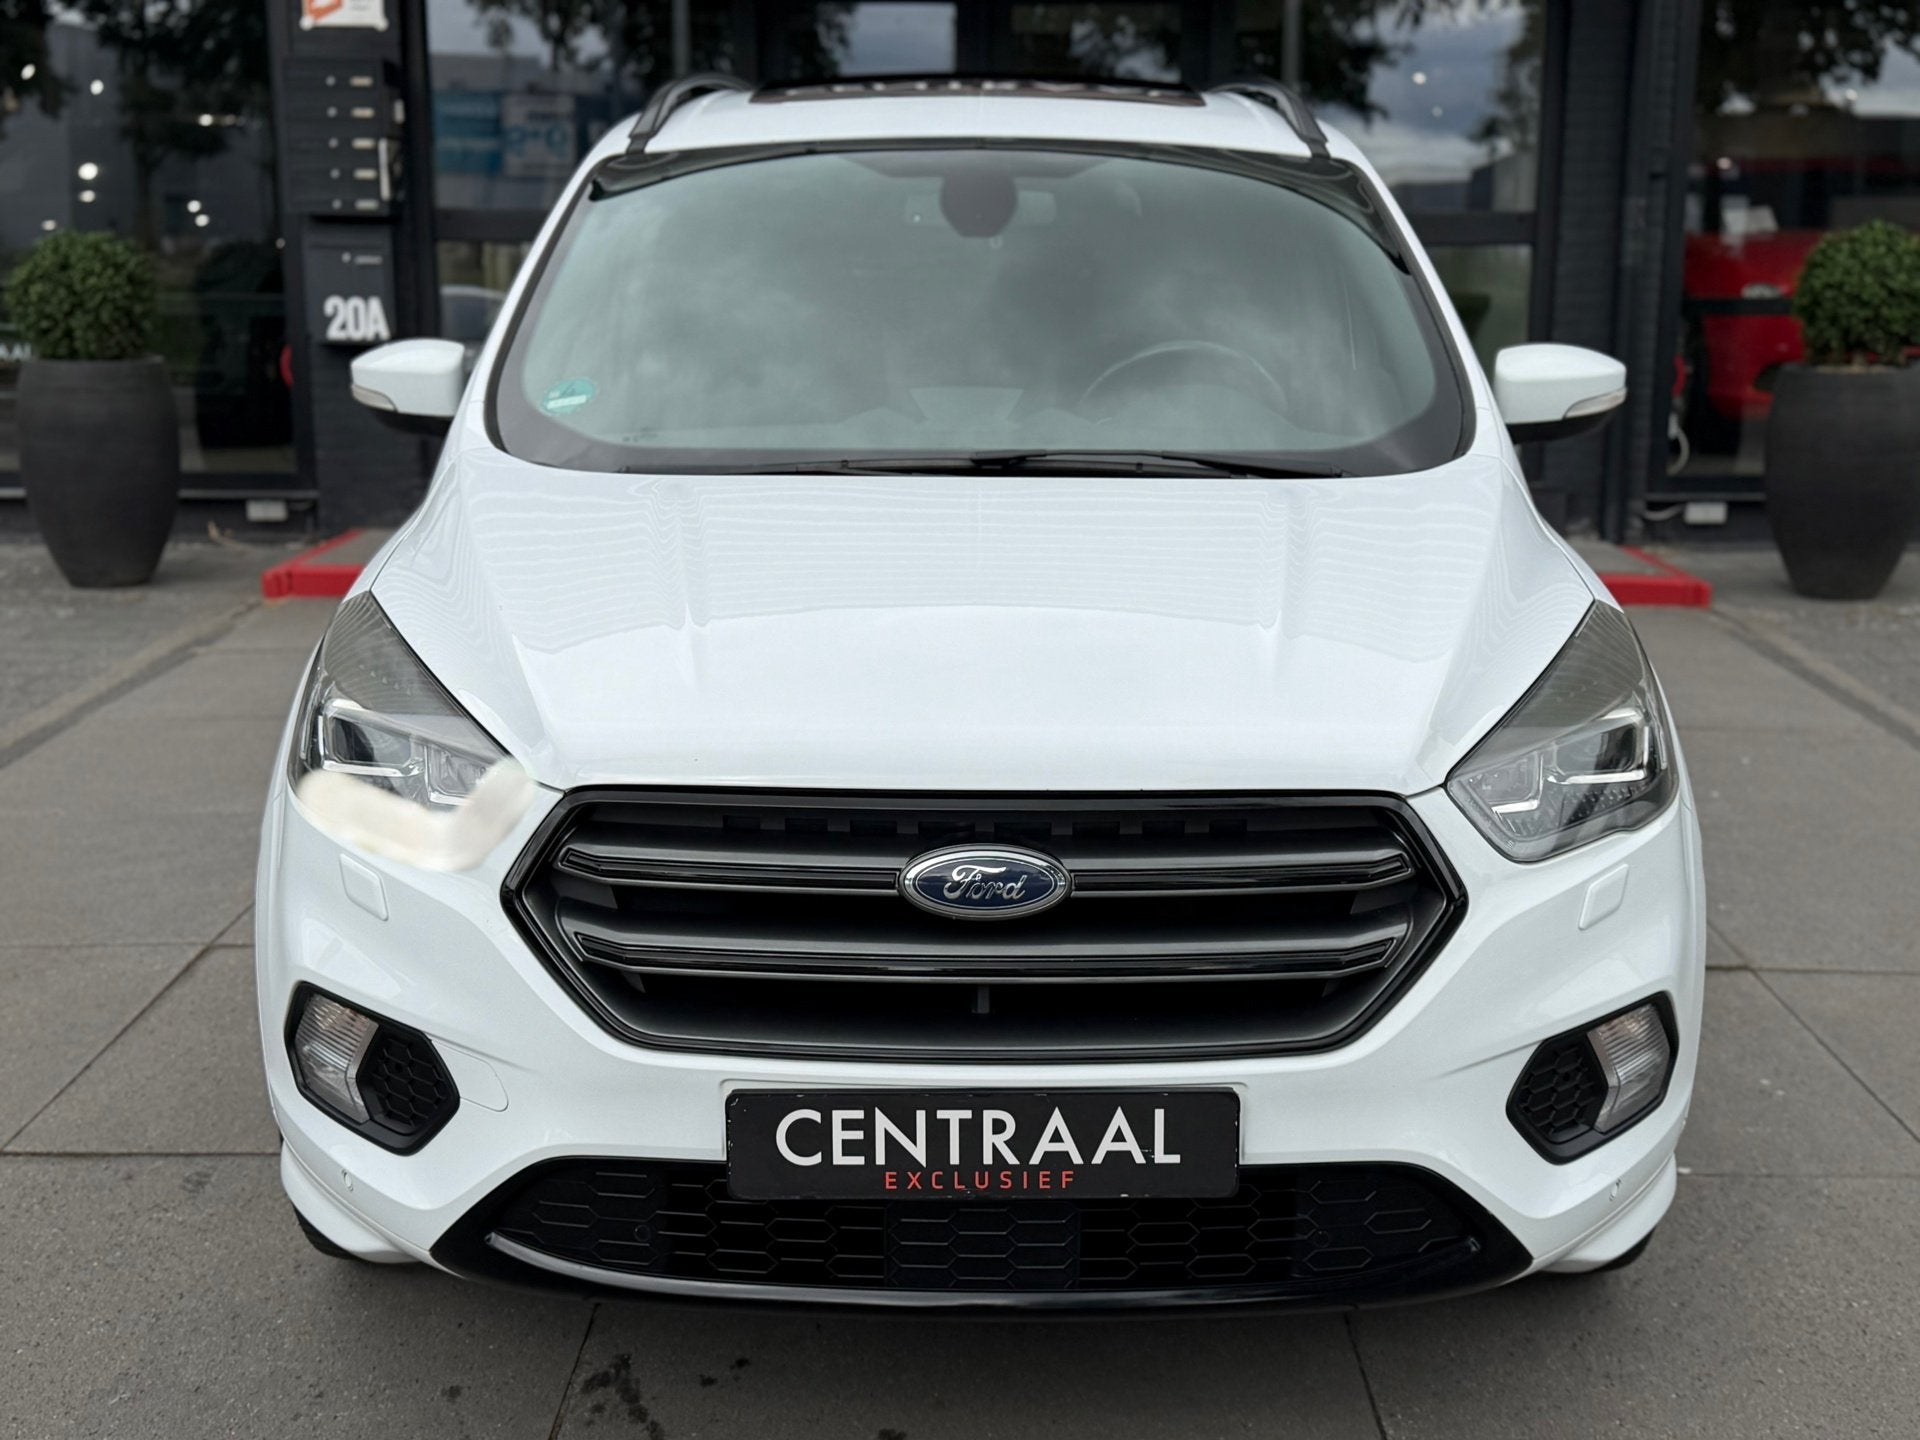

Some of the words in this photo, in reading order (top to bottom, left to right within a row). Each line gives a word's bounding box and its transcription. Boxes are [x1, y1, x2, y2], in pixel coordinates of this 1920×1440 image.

[323, 295, 391, 341] 20A
[943, 864, 1028, 900] Ford
[775, 1106, 1181, 1167] CENTRAAL
[885, 1170, 1075, 1190] EXCLUSIEF
